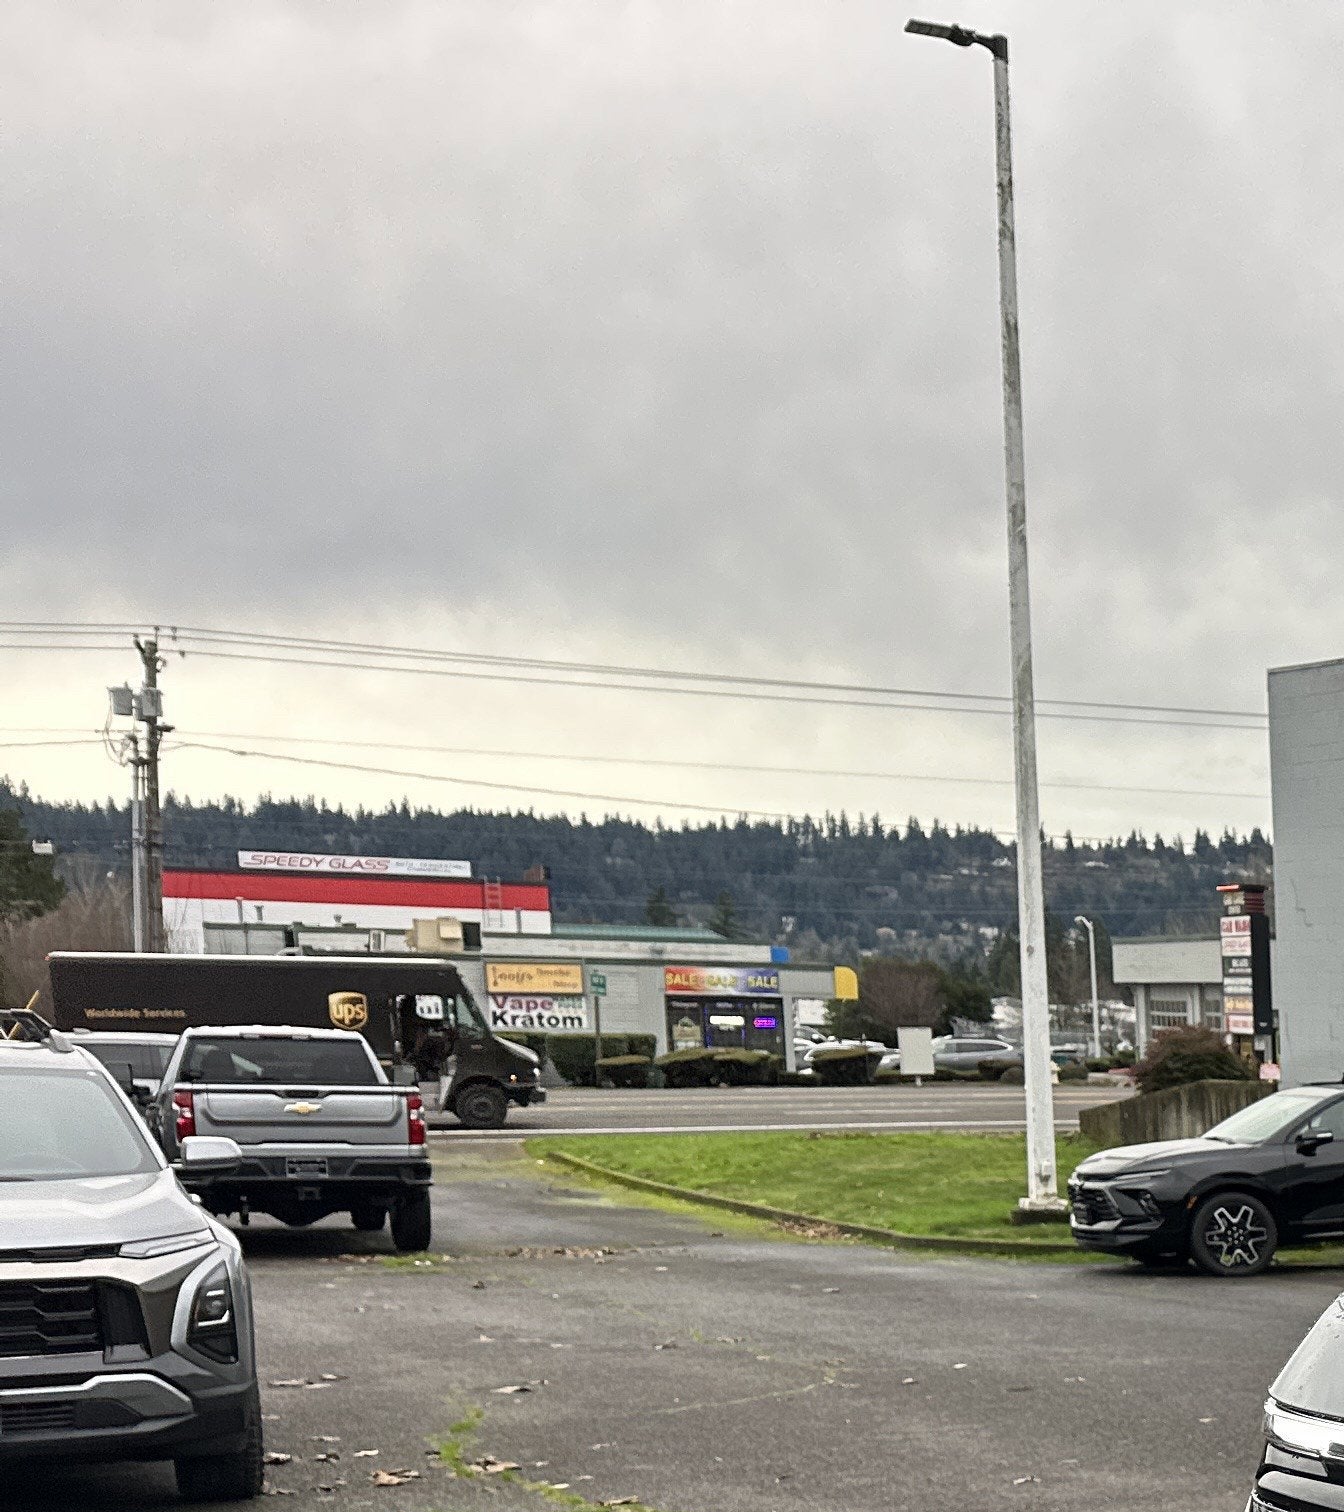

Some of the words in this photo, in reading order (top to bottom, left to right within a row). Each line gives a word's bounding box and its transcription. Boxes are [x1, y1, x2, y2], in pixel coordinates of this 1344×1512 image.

[244, 854, 326, 868] SPEEDY
[328, 857, 391, 871] GLASS
[665, 973, 699, 987] SALE
[747, 975, 778, 988] SALE
[491, 993, 553, 1012] Vape
[333, 1003, 366, 1024] ups
[491, 1010, 583, 1029] Kratom
